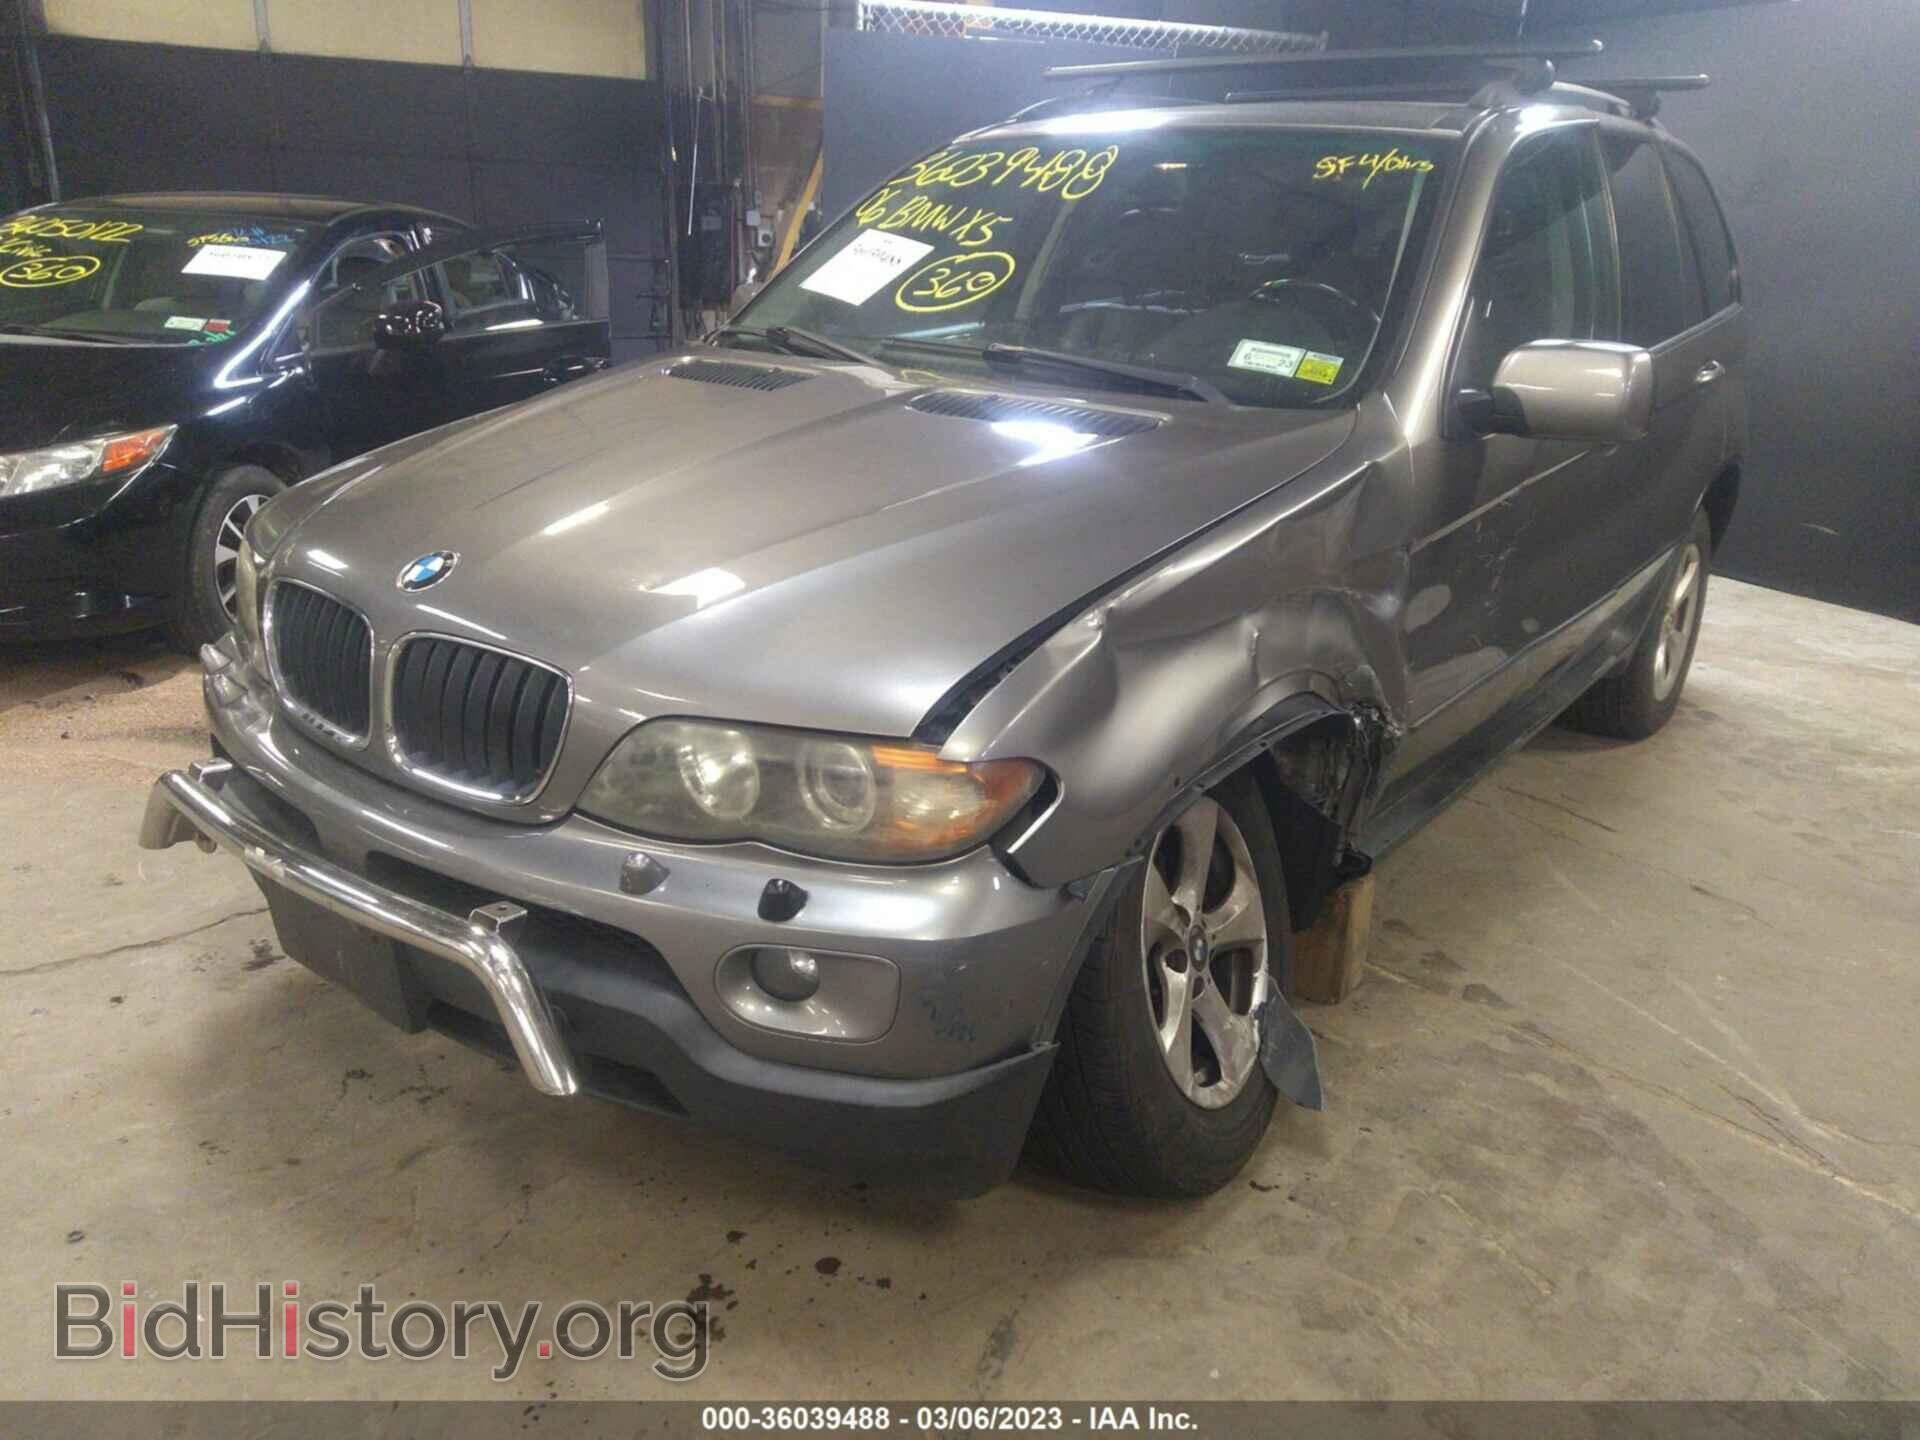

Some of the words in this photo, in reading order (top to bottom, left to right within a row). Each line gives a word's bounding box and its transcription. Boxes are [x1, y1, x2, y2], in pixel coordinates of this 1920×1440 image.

[877, 195, 968, 232] BMW
[948, 207, 1014, 247] X5
[7, 262, 86, 280] 360
